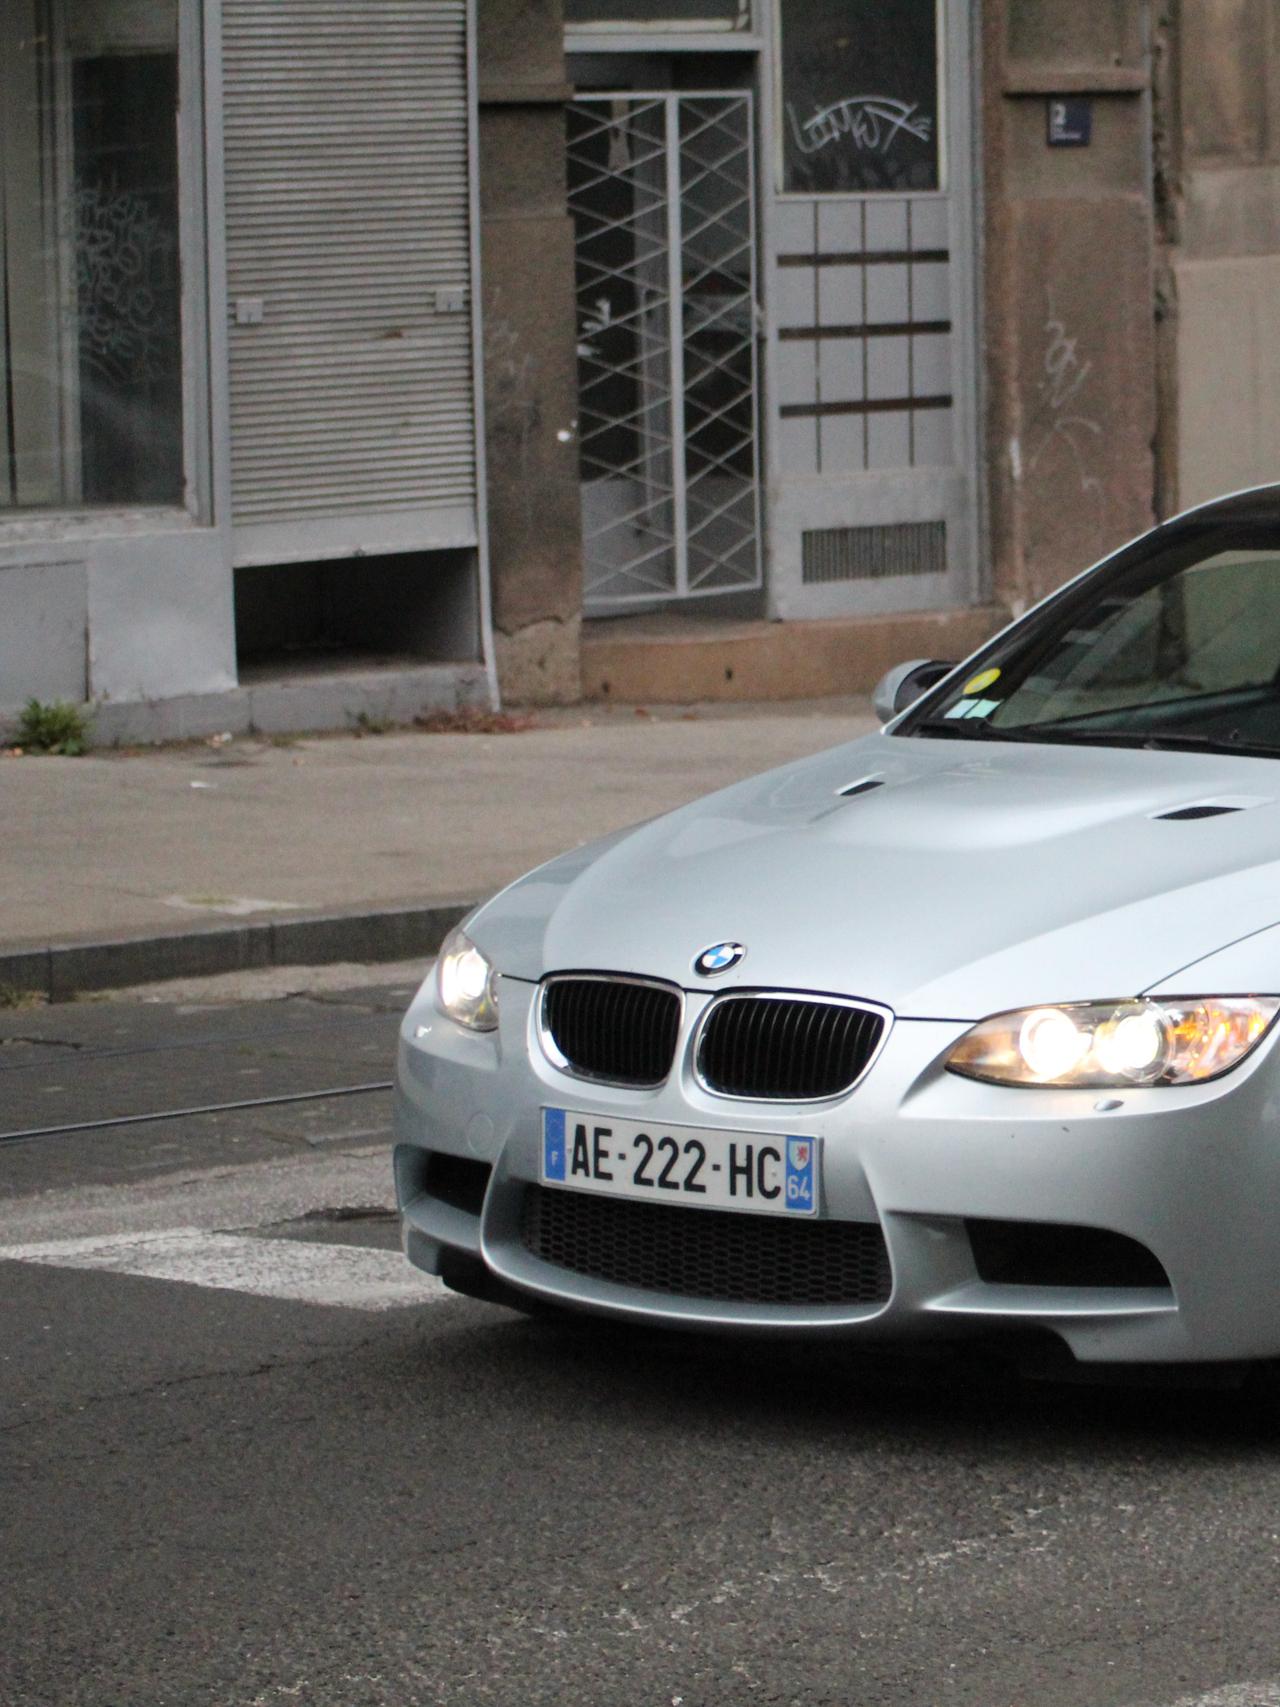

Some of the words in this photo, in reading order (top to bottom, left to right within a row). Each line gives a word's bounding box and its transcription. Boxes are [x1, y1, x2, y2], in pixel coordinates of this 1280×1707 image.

[551, 1150, 559, 1166] F
[571, 1123, 781, 1200] AE-222-HC
[787, 1174, 811, 1200] 64
